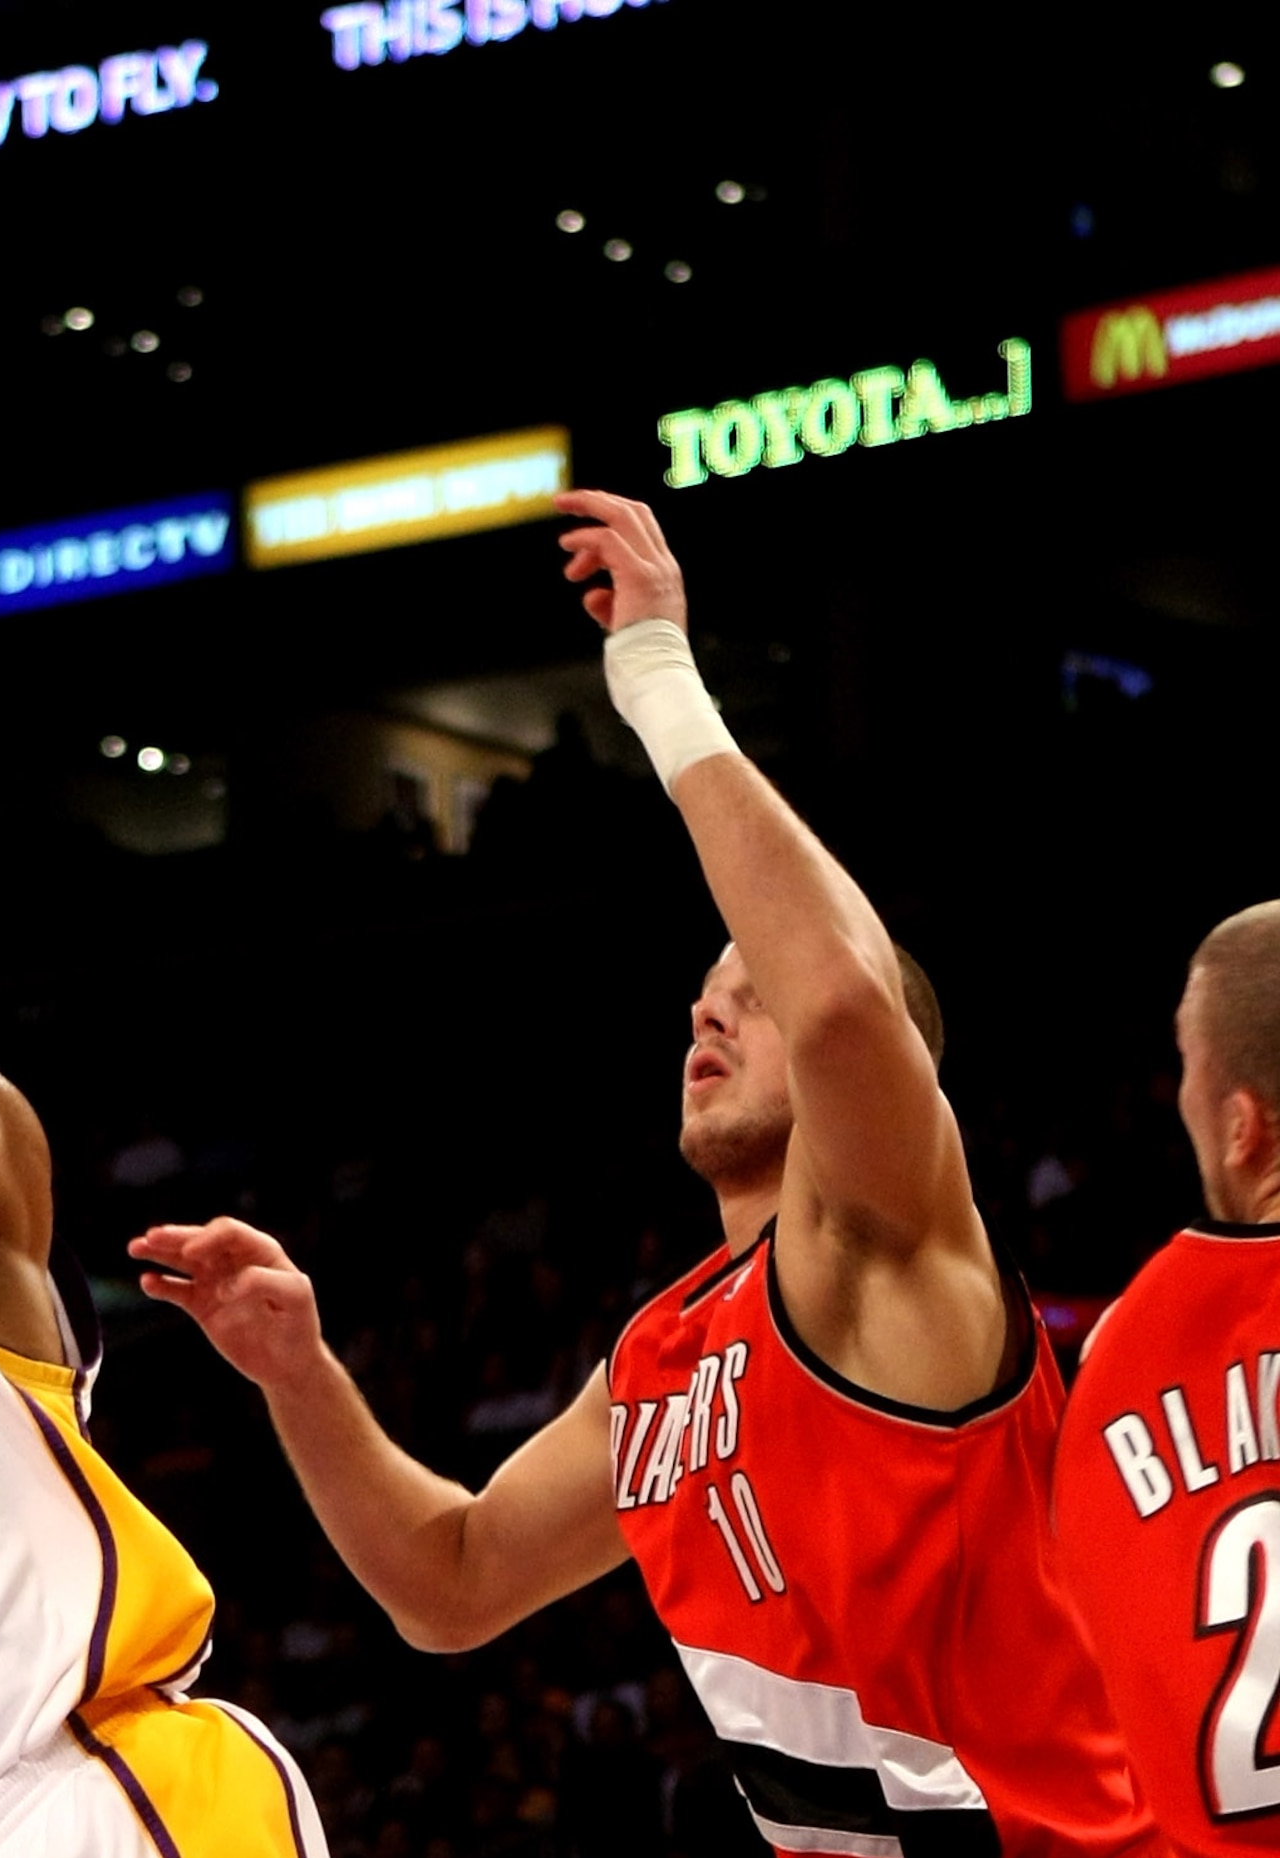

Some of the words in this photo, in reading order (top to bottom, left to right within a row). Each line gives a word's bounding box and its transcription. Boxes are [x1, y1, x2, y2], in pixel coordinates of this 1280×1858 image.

[13, 65, 99, 139] TO
[99, 38, 220, 125] FLY.
[706, 1470, 787, 1603] 10
